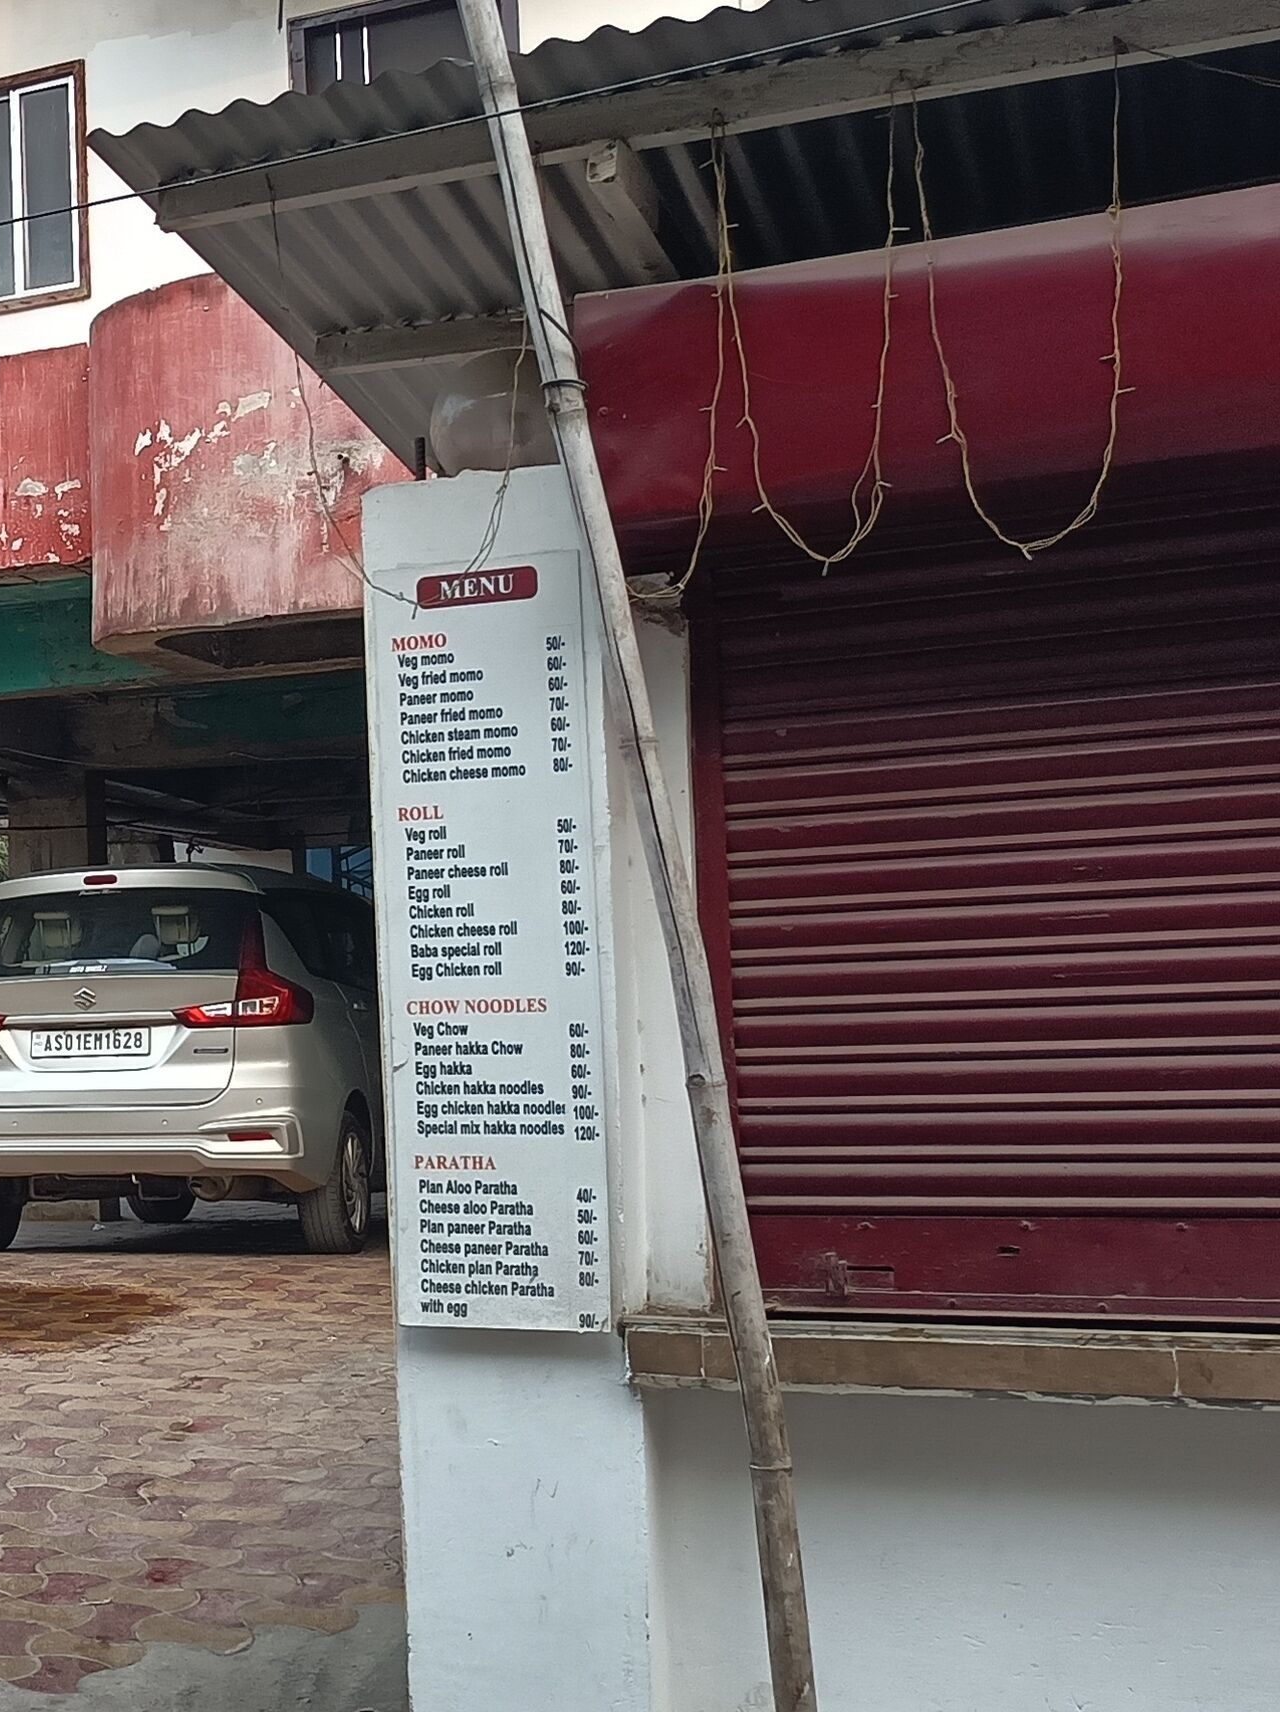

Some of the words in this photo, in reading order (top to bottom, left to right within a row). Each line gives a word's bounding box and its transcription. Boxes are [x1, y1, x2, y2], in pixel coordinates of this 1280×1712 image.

[440, 574, 514, 600] MENU
[392, 634, 447, 651] MOMO
[397, 654, 418, 671] Veg
[420, 653, 455, 666] momo
[545, 635, 566, 652] 50/-
[397, 674, 419, 690] Veg
[420, 670, 447, 686] fried
[449, 670, 484, 683] momo
[546, 656, 567, 672] 60/-
[399, 693, 438, 707] Paneer
[439, 690, 474, 704] momo
[547, 676, 568, 692] 60/-
[400, 712, 438, 726] Paneer
[439, 707, 466, 723] fried
[468, 708, 503, 721] momo
[548, 696, 570, 712] 70/-
[400, 730, 445, 745] Chicken
[447, 728, 481, 742] steam
[483, 726, 519, 739] momo
[550, 717, 571, 732] 60/-
[401, 749, 446, 765] Chicken
[447, 746, 474, 761] fried
[476, 747, 512, 759] momo
[551, 737, 572, 752] 70/-
[402, 769, 447, 784] Chicken
[449, 767, 489, 781] cheese
[491, 765, 526, 778] momo
[552, 757, 573, 773] 80/-
[398, 806, 444, 821] ROLL
[404, 828, 426, 845] Veg
[428, 826, 447, 841] roll
[556, 818, 577, 834] 50/-
[406, 847, 445, 862] Paneer
[446, 845, 466, 860] roll
[557, 839, 578, 854] 70/-
[407, 867, 446, 881] Paneer
[447, 865, 487, 879] cheese
[489, 862, 509, 877] roll
[559, 859, 580, 874] 80/-
[408, 886, 430, 903] Egg
[432, 885, 451, 899] roll
[560, 880, 581, 895] 60/-
[408, 905, 454, 920] Chicken
[455, 903, 475, 918] roll
[561, 900, 582, 915] 80/-
[409, 924, 455, 939] Chicken
[456, 923, 496, 938] cheese
[498, 921, 518, 936] roll
[562, 920, 589, 936] 100/-
[410, 944, 439, 959] Baba
[440, 942, 481, 961] special
[483, 942, 502, 956] roll
[564, 941, 590, 956] 120/-
[411, 964, 433, 982] Egg
[435, 963, 481, 978] Chicken
[483, 962, 502, 976] roll
[565, 962, 586, 977] 90/-
[407, 1001, 461, 1015] CHOW
[465, 1000, 547, 1014] NOODLES
[43, 1031, 143, 1052] AS01EM1628
[412, 1023, 435, 1040] Veg
[436, 1022, 469, 1037] Chow
[568, 1023, 589, 1038] 60/-
[414, 1042, 453, 1056] Paneer
[455, 1041, 489, 1056] hakka
[491, 1041, 524, 1056] Chow
[569, 1044, 590, 1059] 80/-
[415, 1062, 437, 1080] Egg
[439, 1061, 473, 1076] hakka
[570, 1064, 592, 1080] 60/-
[415, 1081, 461, 1096] Chicken
[463, 1081, 497, 1095] hakka
[499, 1081, 545, 1095] noodles
[571, 1085, 592, 1100] 90/-
[416, 1101, 439, 1119] Egg
[440, 1101, 485, 1115] chicken
[486, 1101, 521, 1115] hakka
[572, 1105, 599, 1121] 100/-
[417, 1120, 458, 1138] Special
[460, 1121, 481, 1135] mix
[483, 1121, 517, 1135] hakka
[519, 1121, 565, 1136] noodles
[574, 1126, 600, 1141] 120/-
[414, 1156, 497, 1170] PARATHA
[418, 1180, 444, 1194] Plan
[445, 1180, 472, 1195] Aloo
[474, 1180, 518, 1196] Paratha
[576, 1189, 597, 1204] 40/-
[419, 1199, 461, 1215] Cheese
[463, 1201, 488, 1215] aloo
[490, 1201, 534, 1216] Paratha
[577, 1210, 598, 1225] 50/-
[419, 1219, 445, 1234] Plan
[447, 1223, 486, 1238] paneer
[488, 1221, 532, 1236] Paratha
[577, 1230, 599, 1246] 60/-
[419, 1239, 462, 1255] Cheese
[464, 1244, 503, 1258] paneer
[504, 1241, 549, 1257] Paratha
[577, 1251, 599, 1266] 70/-
[420, 1259, 466, 1275] Chicken
[468, 1261, 493, 1278] plan
[495, 1261, 539, 1278] Paratha
[578, 1272, 600, 1287] 80/-
[420, 1279, 462, 1295] Cheese
[464, 1280, 508, 1296] chicken
[511, 1282, 555, 1298] Paratha
[420, 1299, 444, 1314] with
[446, 1303, 468, 1318] egg
[578, 1314, 600, 1329] 90/-
